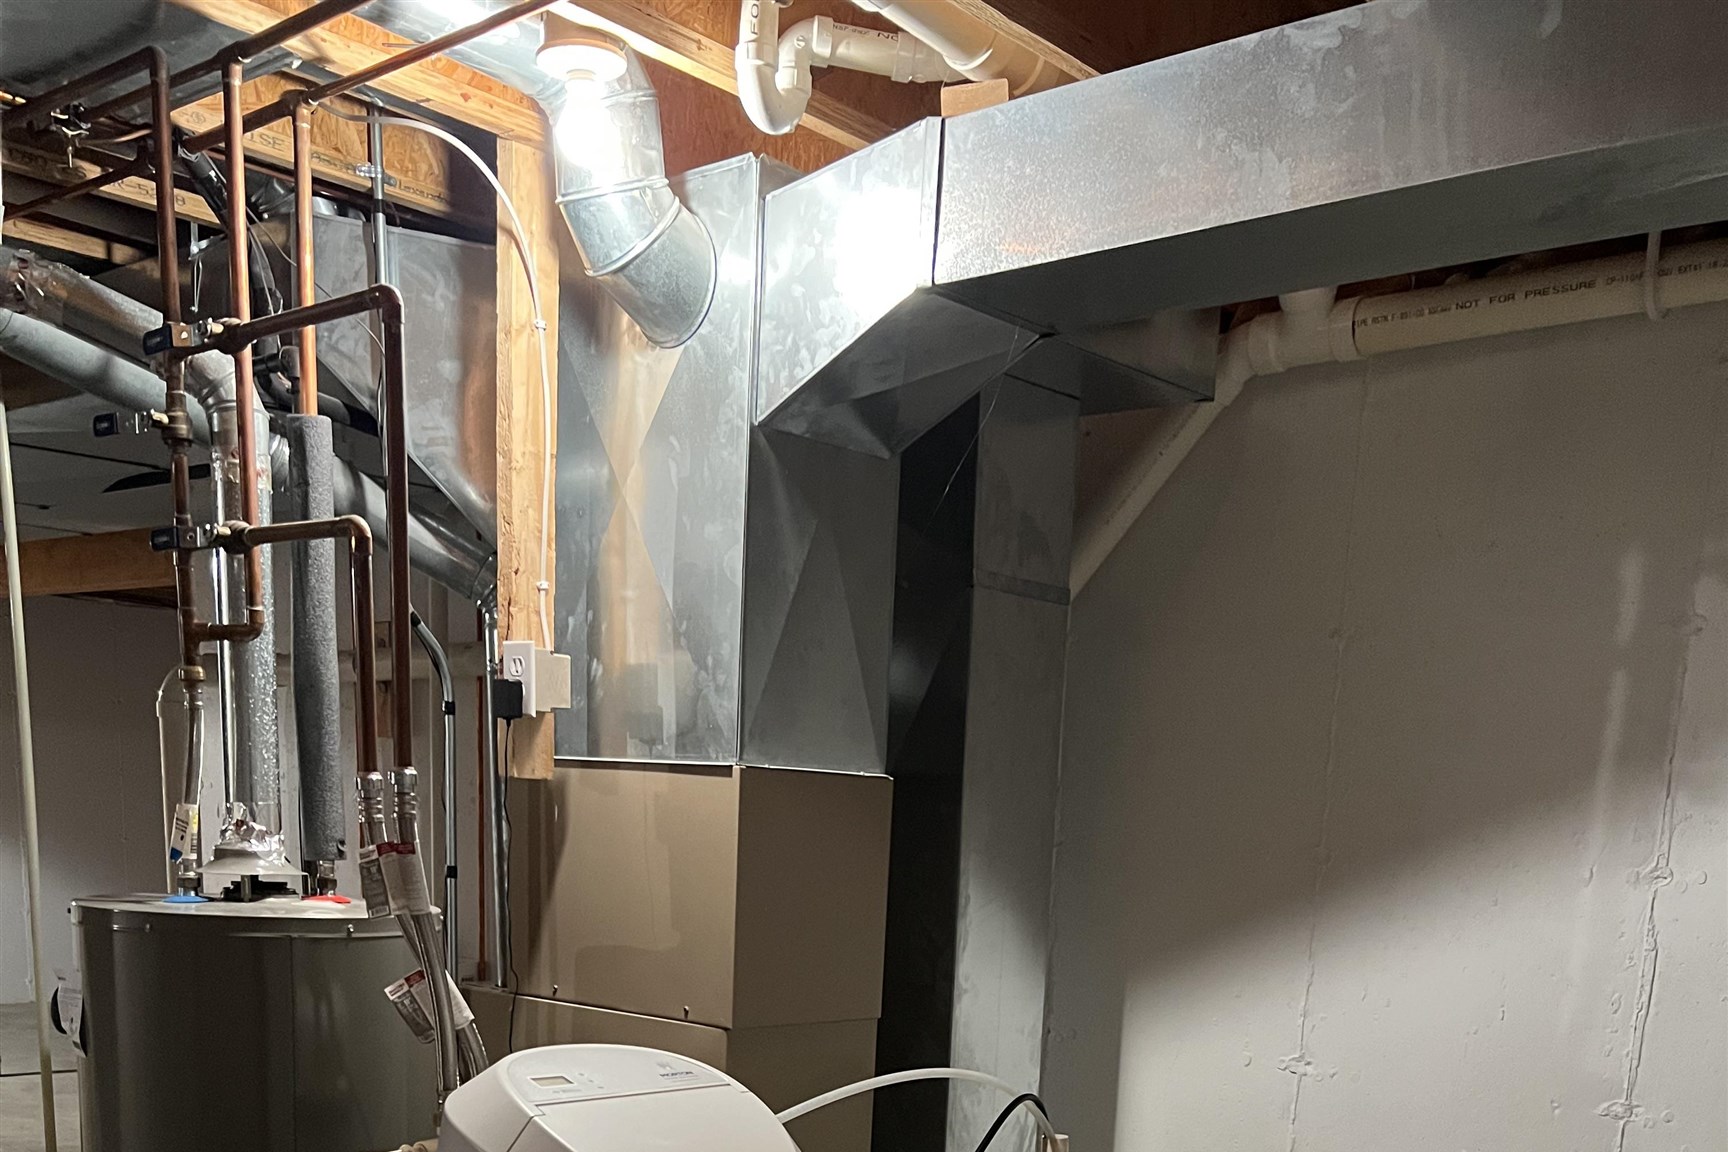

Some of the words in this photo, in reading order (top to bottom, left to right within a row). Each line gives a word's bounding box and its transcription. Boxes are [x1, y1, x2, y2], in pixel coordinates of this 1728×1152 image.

[1455, 299, 1480, 310] NOT
[1489, 293, 1515, 304] FOR
[1524, 279, 1597, 300] PRESSURE
